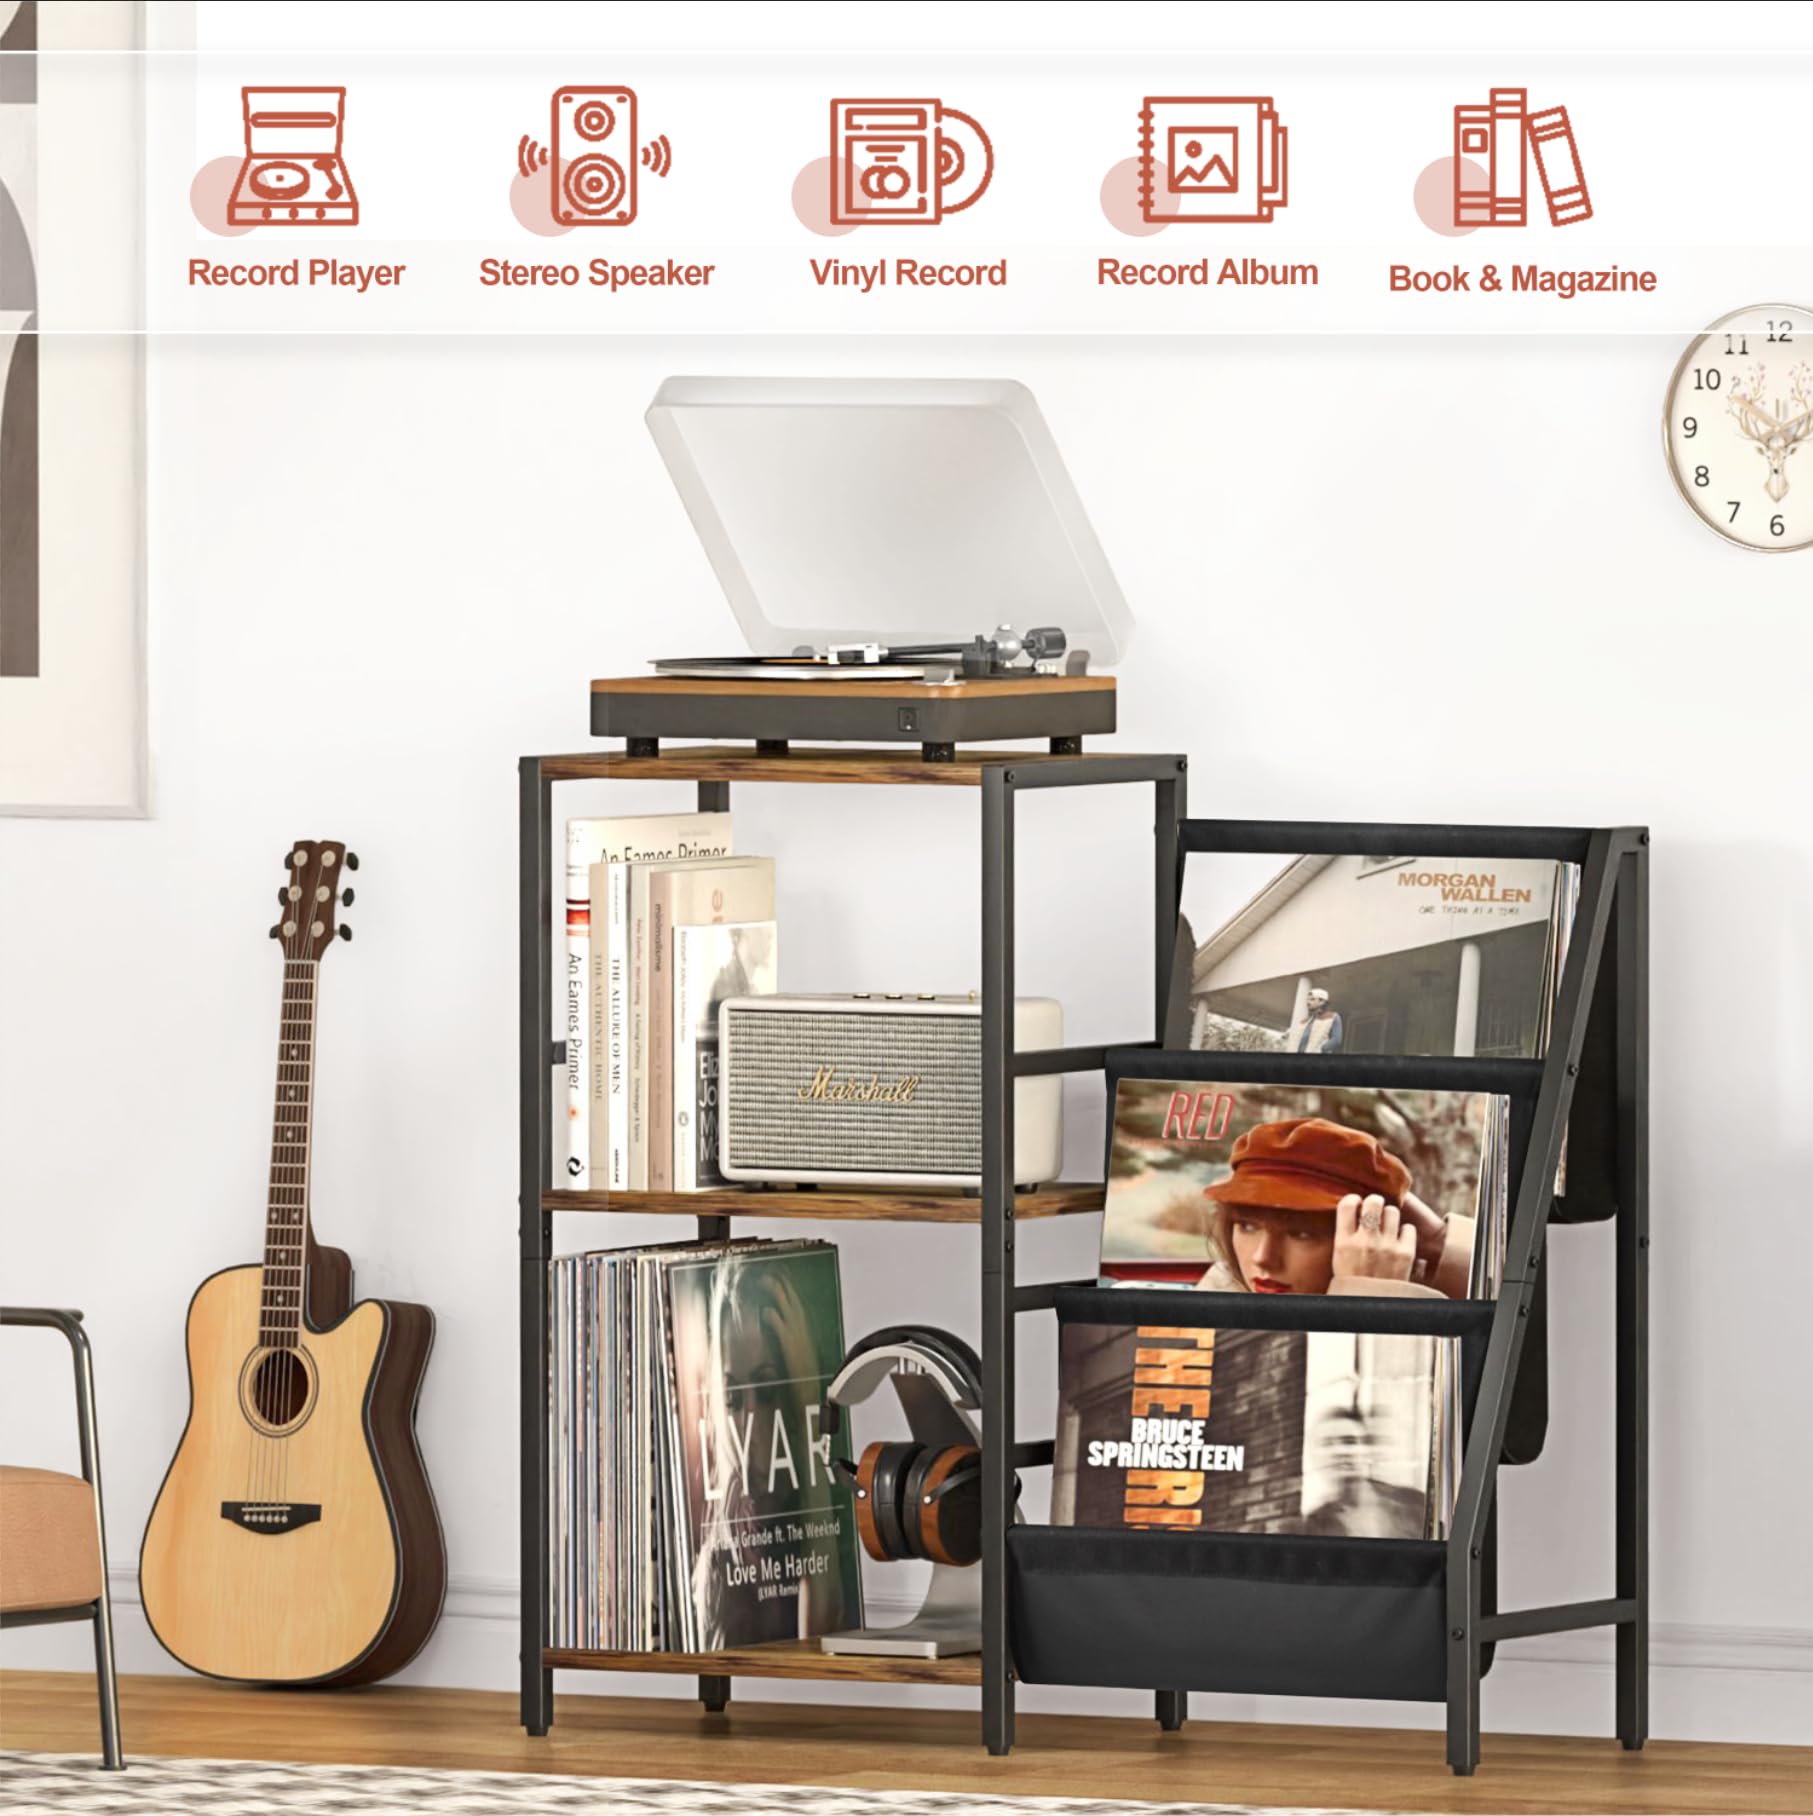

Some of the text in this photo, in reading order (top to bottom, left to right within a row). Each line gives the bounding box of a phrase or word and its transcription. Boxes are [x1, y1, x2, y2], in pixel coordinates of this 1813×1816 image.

[1725, 333, 1749, 355] 11
[1766, 320, 1793, 342] 12
[1693, 368, 1721, 390] 10
[1682, 416, 1698, 439] 9
[1694, 465, 1710, 488] 8
[1727, 501, 1741, 523] 7
[1769, 514, 1785, 537] 6
[1397, 872, 1496, 888] MORGAN
[1441, 887, 1532, 903] WALLEN
[654, 903, 663, 973] minimalisme
[568, 953, 583, 1091] An Eames Primer
[594, 954, 603, 1103] THE AUTHENTIC HOME
[611, 958, 620, 1095] THE ALLURE OF MEN
[797, 1063, 921, 1104] Marshall
[1161, 1089, 1236, 1141] RED
[1131, 1326, 1216, 1419] THE
[1131, 1417, 1206, 1446] BRUCE
[700, 1404, 837, 1501] LYAR
[1087, 1440, 1245, 1472] SPRINGSTEEN
[1124, 1469, 1205, 1531] RI
[741, 1528, 773, 1548] Grande
[775, 1526, 785, 1543] ft.
[787, 1523, 803, 1542] The
[805, 1518, 841, 1539] Weeknd
[726, 1550, 829, 1587] Love Me Harder
